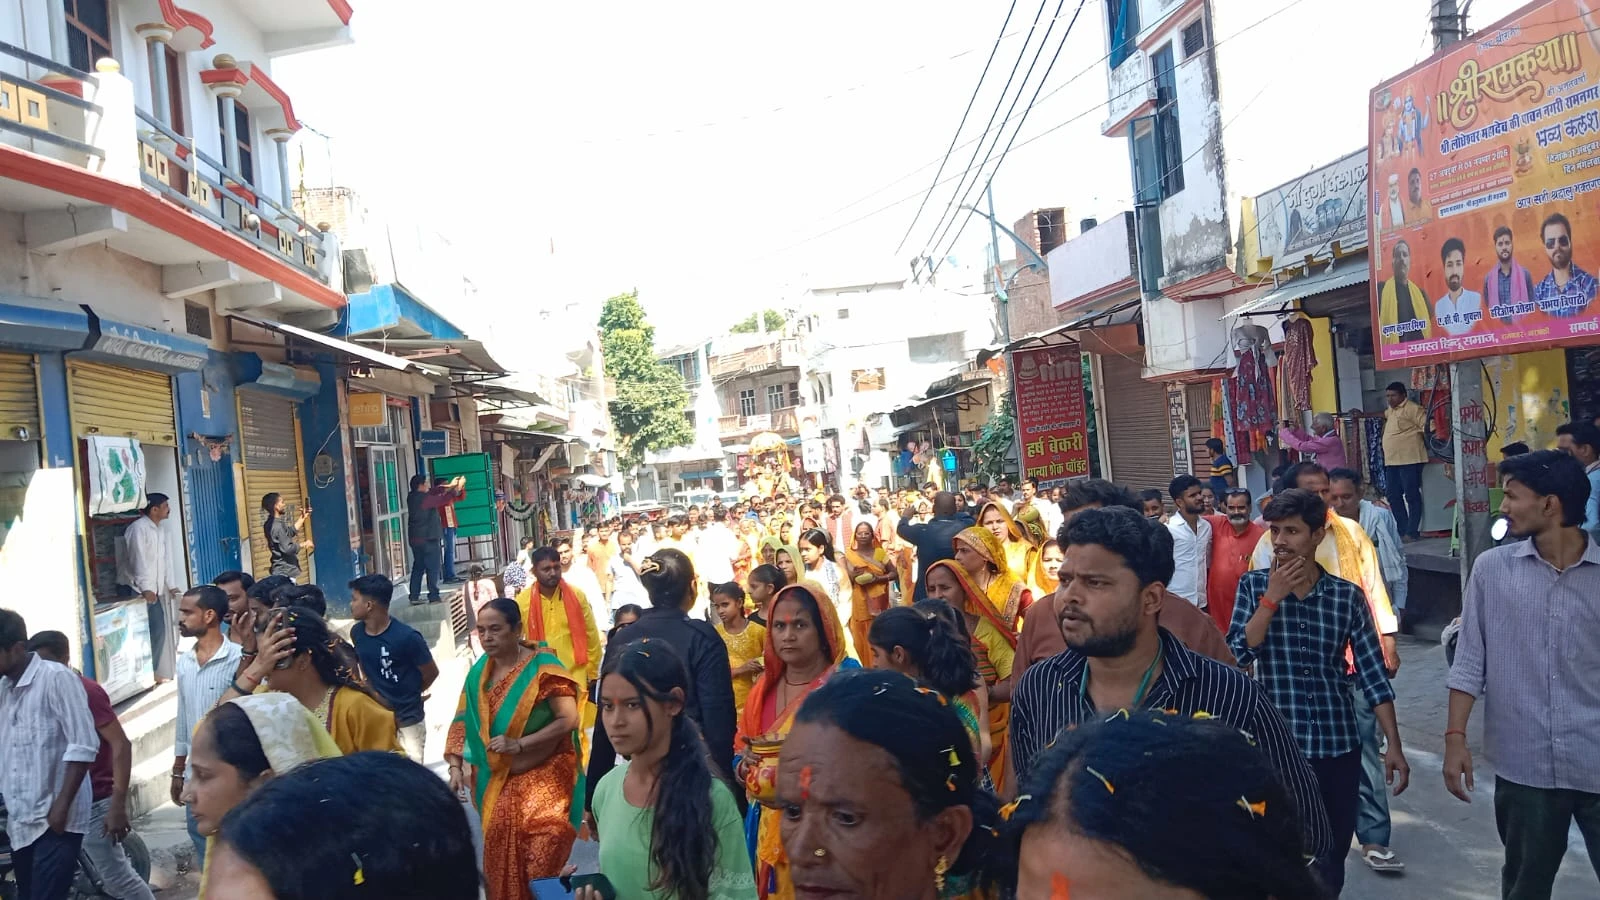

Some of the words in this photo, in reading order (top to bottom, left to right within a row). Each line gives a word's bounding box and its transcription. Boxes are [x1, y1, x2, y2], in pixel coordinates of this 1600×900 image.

[1440, 138, 1450, 154] श्री
[1481, 120, 1508, 139] महादेव
[1508, 114, 1521, 130] की
[1521, 108, 1542, 125] पावन
[1543, 99, 1563, 117] नगरी
[1564, 86, 1600, 109] रामनगर
[1536, 124, 1562, 146] भव्य
[1564, 110, 1600, 138] कलश
[1490, 304, 1515, 318] हरिओम
[1515, 301, 1536, 315] ओझा
[1540, 298, 1561, 311] अभय
[1561, 293, 1587, 308] त्रिपाठी
[1408, 341, 1439, 353] समस्त
[1440, 337, 1465, 351] हिन्दू
[1026, 436, 1045, 457] हर्ष
[1047, 432, 1083, 454] बेकरी
[182, 471, 195, 546] CEMENT
